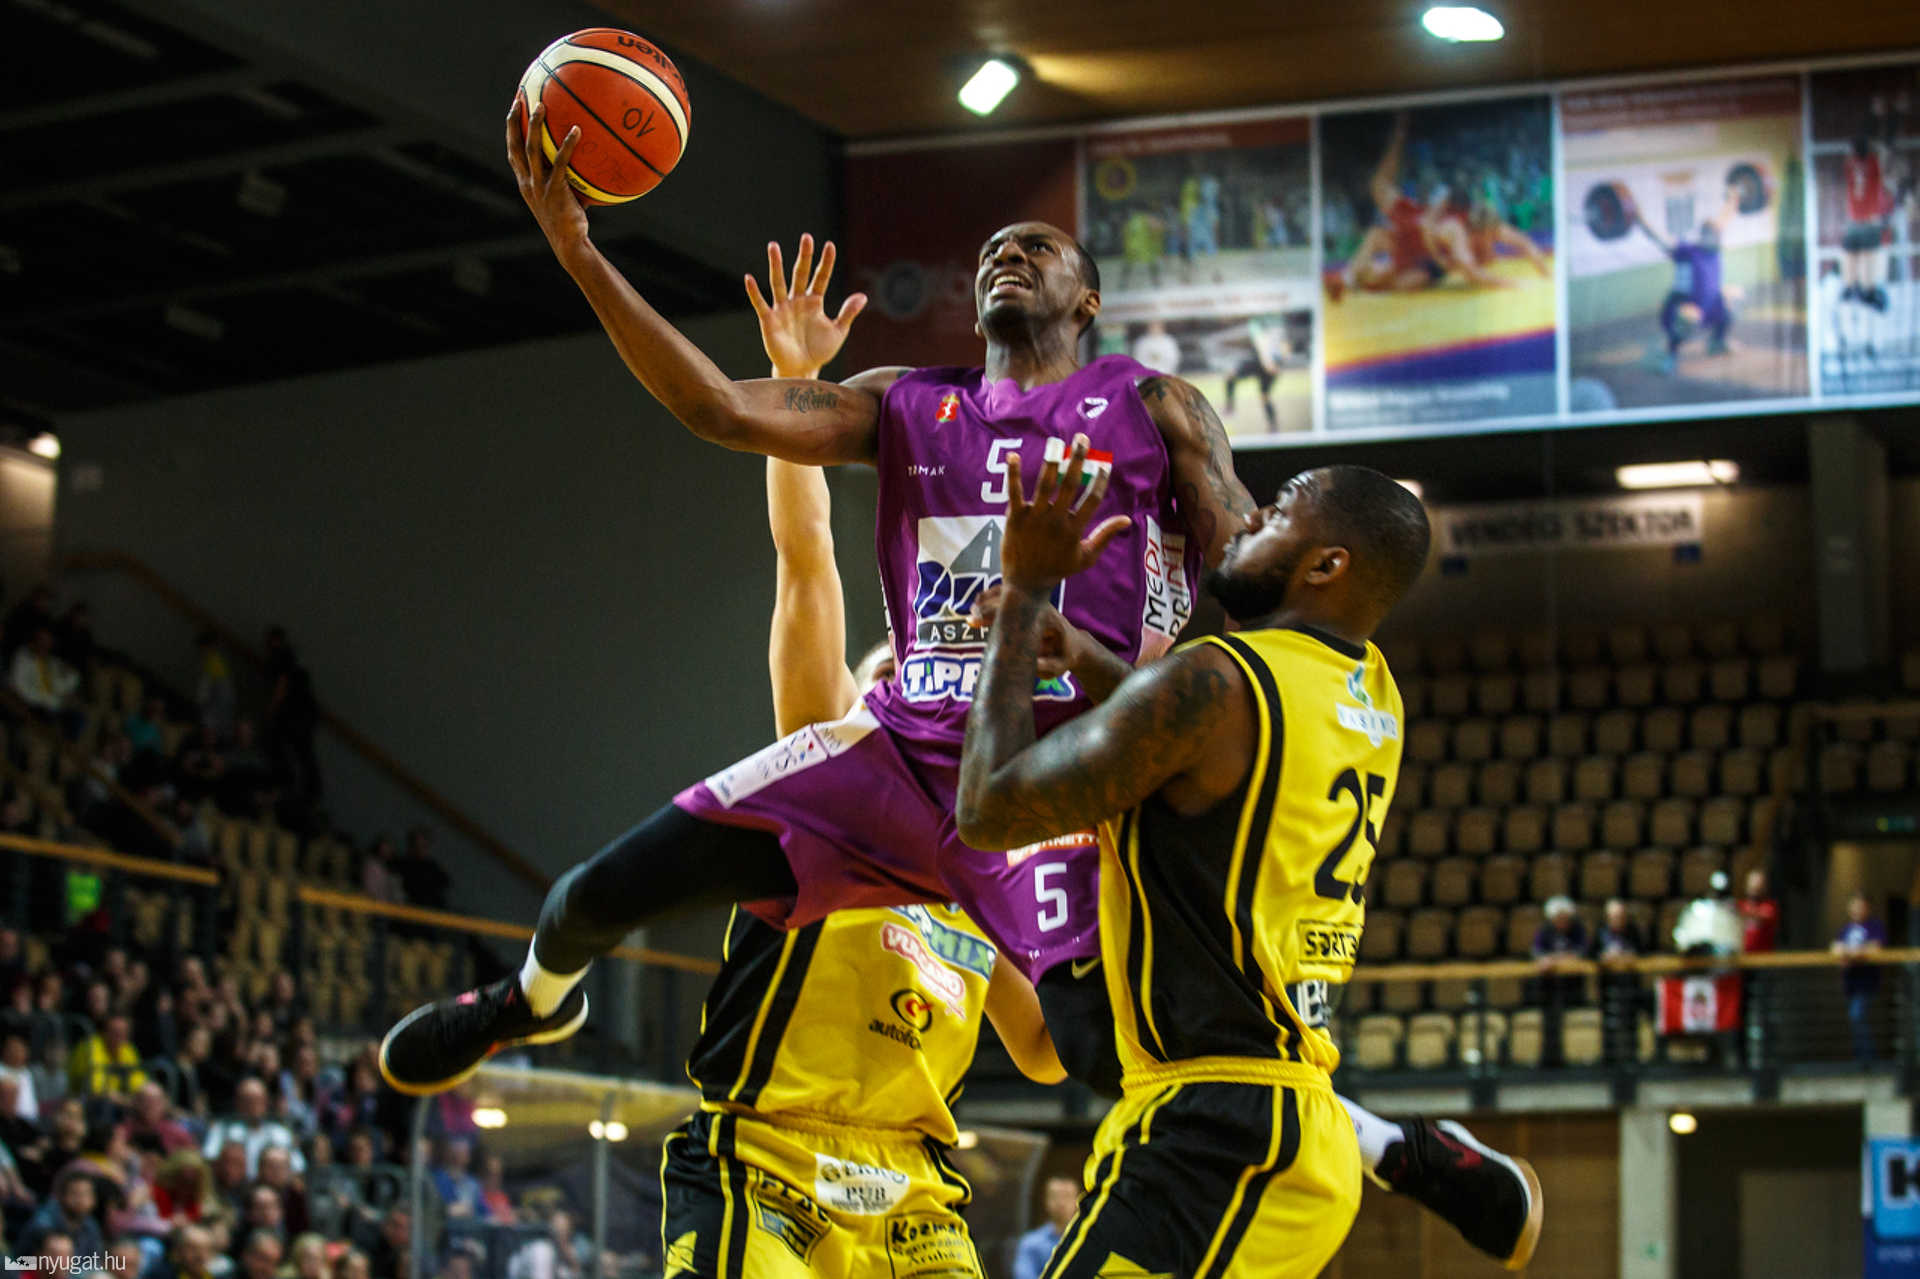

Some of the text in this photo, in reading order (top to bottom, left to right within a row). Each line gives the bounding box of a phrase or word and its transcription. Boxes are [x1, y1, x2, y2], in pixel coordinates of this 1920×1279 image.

[617, 35, 687, 94] lten
[981, 438, 1023, 504] 5
[1315, 767, 1386, 905] 25
[1034, 862, 1068, 933] 5
